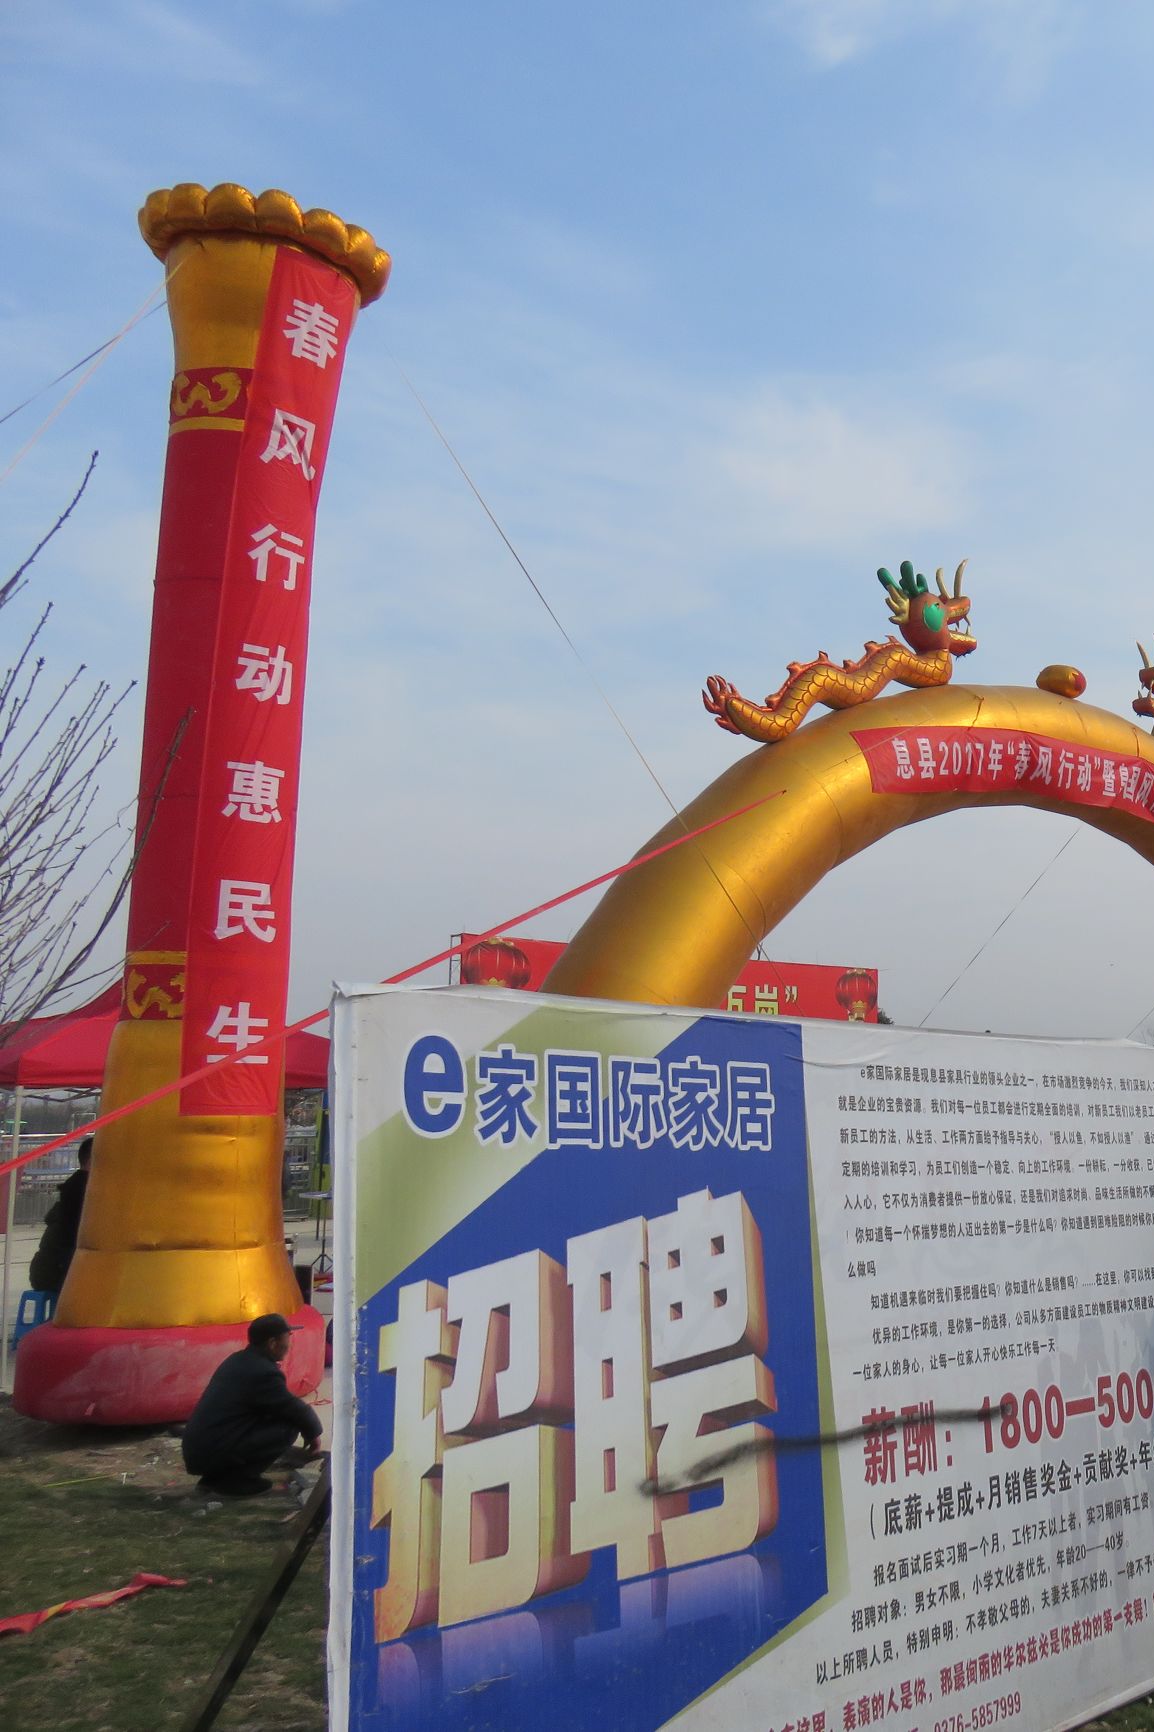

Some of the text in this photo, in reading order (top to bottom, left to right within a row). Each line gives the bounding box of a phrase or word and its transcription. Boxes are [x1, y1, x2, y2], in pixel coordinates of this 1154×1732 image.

[205, 298, 339, 1064] 春风行动惠民生
[404, 1033, 776, 1152] e家国际家居
[847, 1260, 877, 1278] 么做吗
[372, 1185, 779, 1645] 招聘
